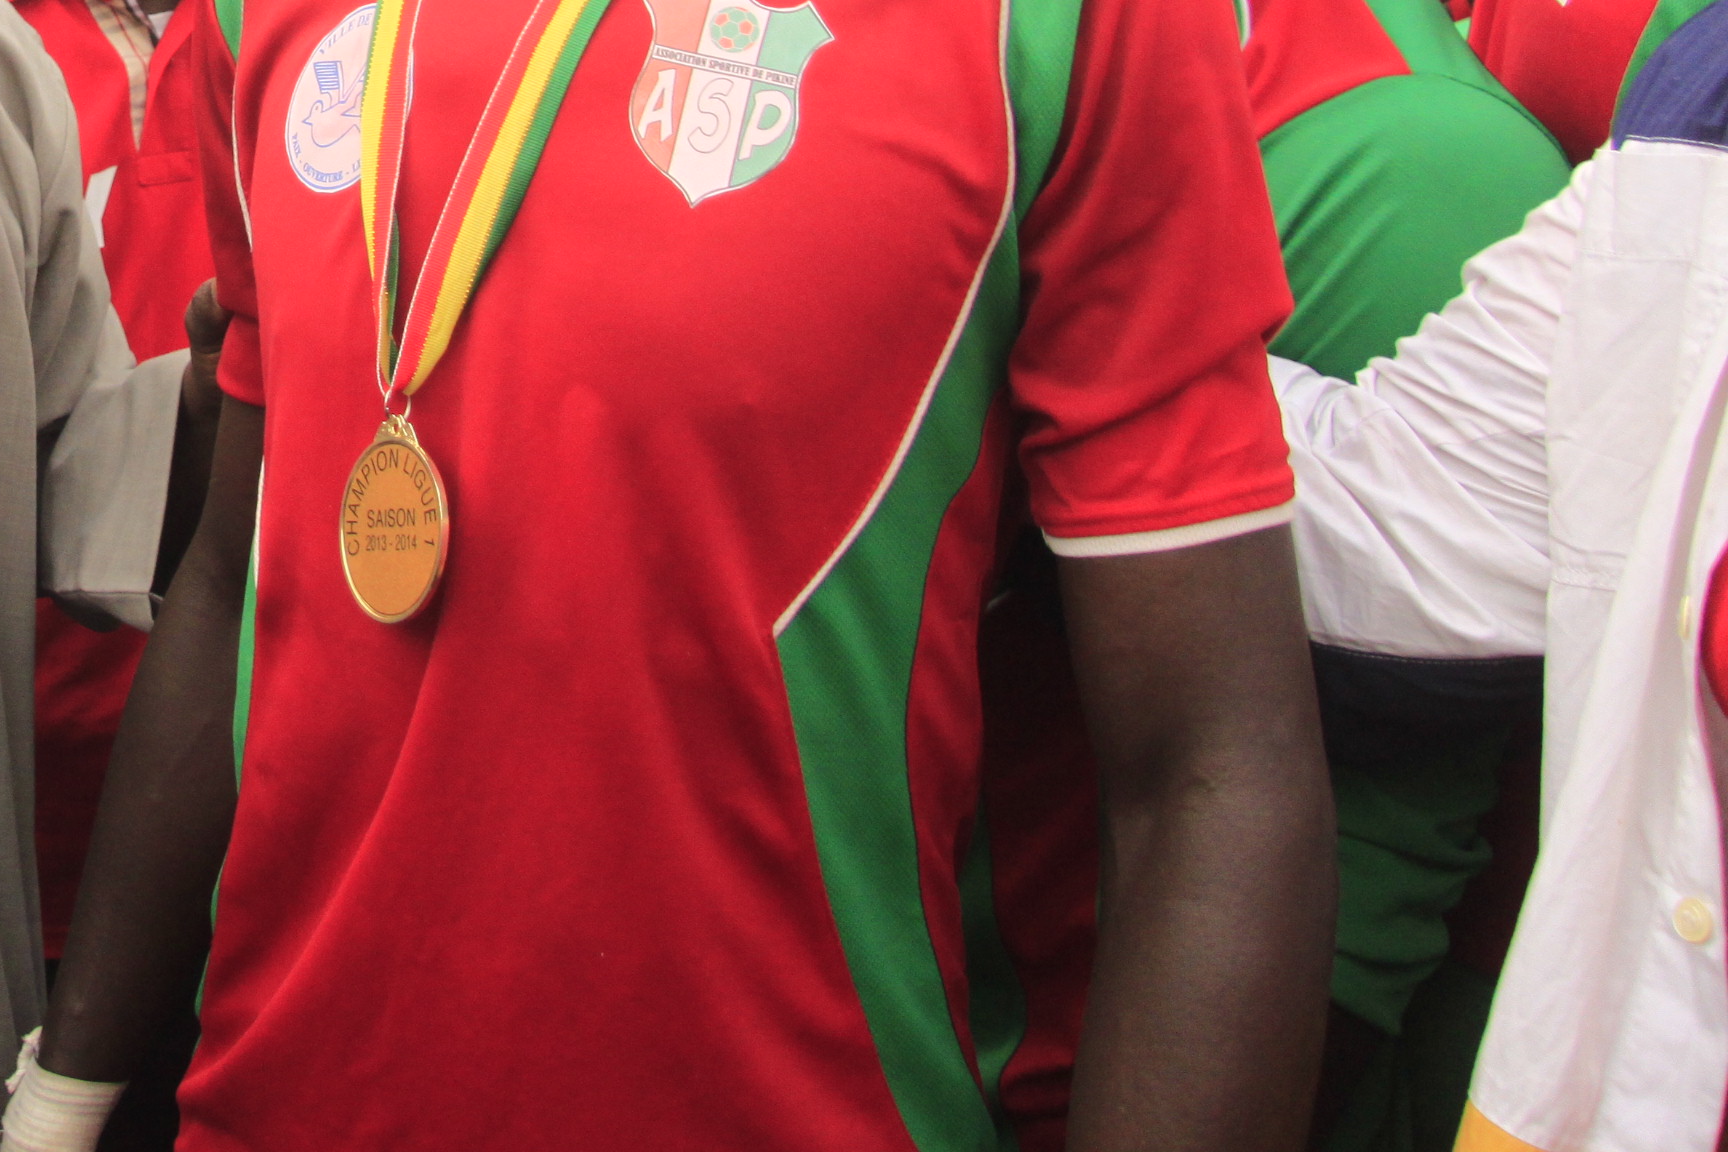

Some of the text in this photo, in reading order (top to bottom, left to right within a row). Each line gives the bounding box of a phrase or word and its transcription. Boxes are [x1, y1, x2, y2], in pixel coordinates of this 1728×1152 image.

[357, 13, 373, 27] DE
[709, 59, 751, 76] SPORTIVE
[752, 67, 764, 79] DE
[637, 68, 793, 161] ASP
[346, 448, 399, 556] CHAMPION
[403, 453, 437, 525] LIGUE
[367, 508, 416, 528] SAISON
[366, 534, 387, 551] 2013
[395, 534, 417, 551] 2014
